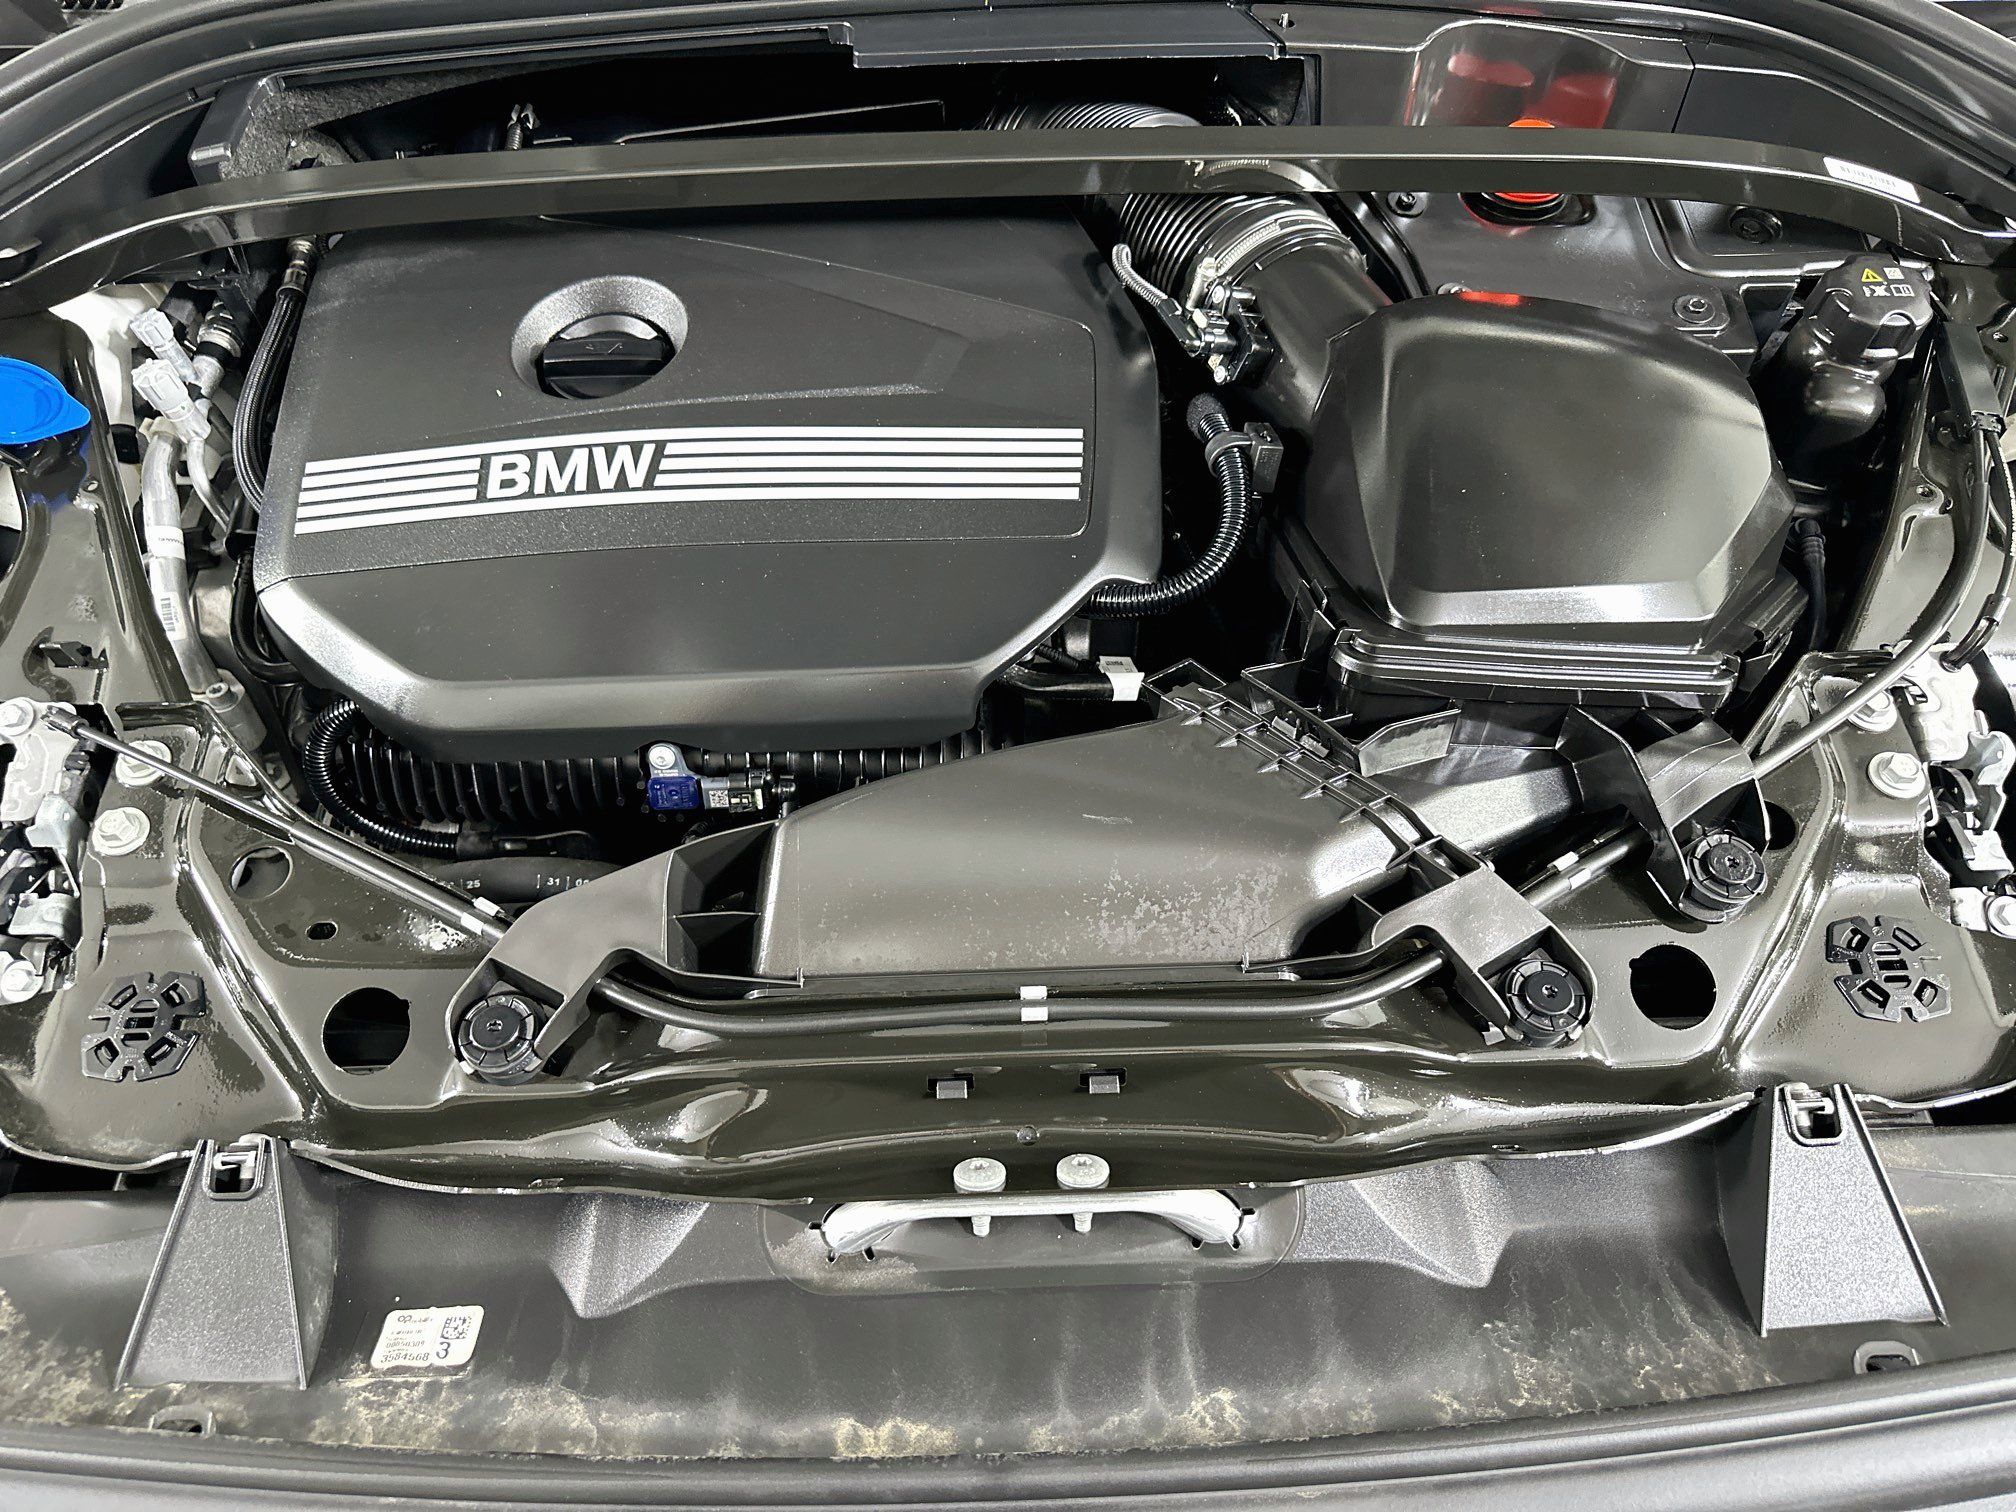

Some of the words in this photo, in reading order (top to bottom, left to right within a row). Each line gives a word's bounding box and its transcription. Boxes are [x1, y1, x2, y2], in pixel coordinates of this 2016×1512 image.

[486, 443, 656, 499] BMW
[466, 879, 481, 889] 25
[546, 877, 560, 886] 31
[436, 1341, 451, 1359] 3
